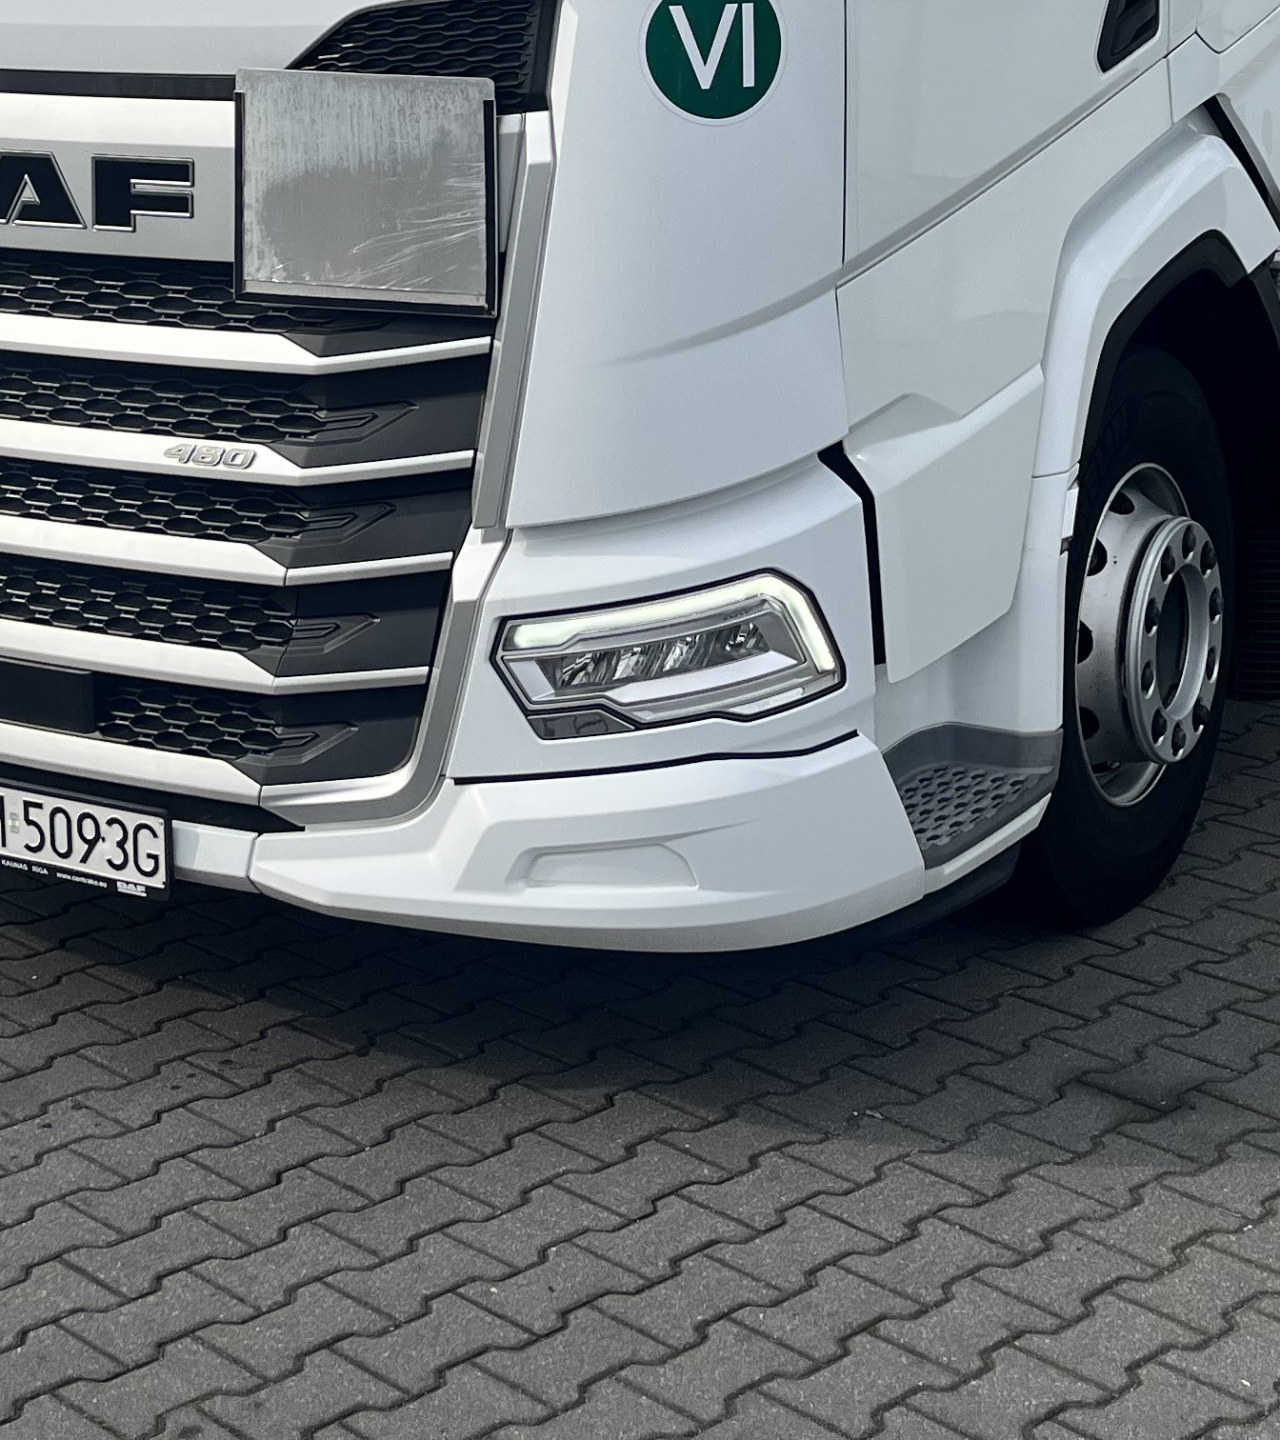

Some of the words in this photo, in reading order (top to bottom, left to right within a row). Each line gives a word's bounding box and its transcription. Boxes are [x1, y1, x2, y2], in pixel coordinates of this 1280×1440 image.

[668, 2, 755, 90] VI
[163, 443, 258, 470] 480
[23, 798, 160, 878] 5093G
